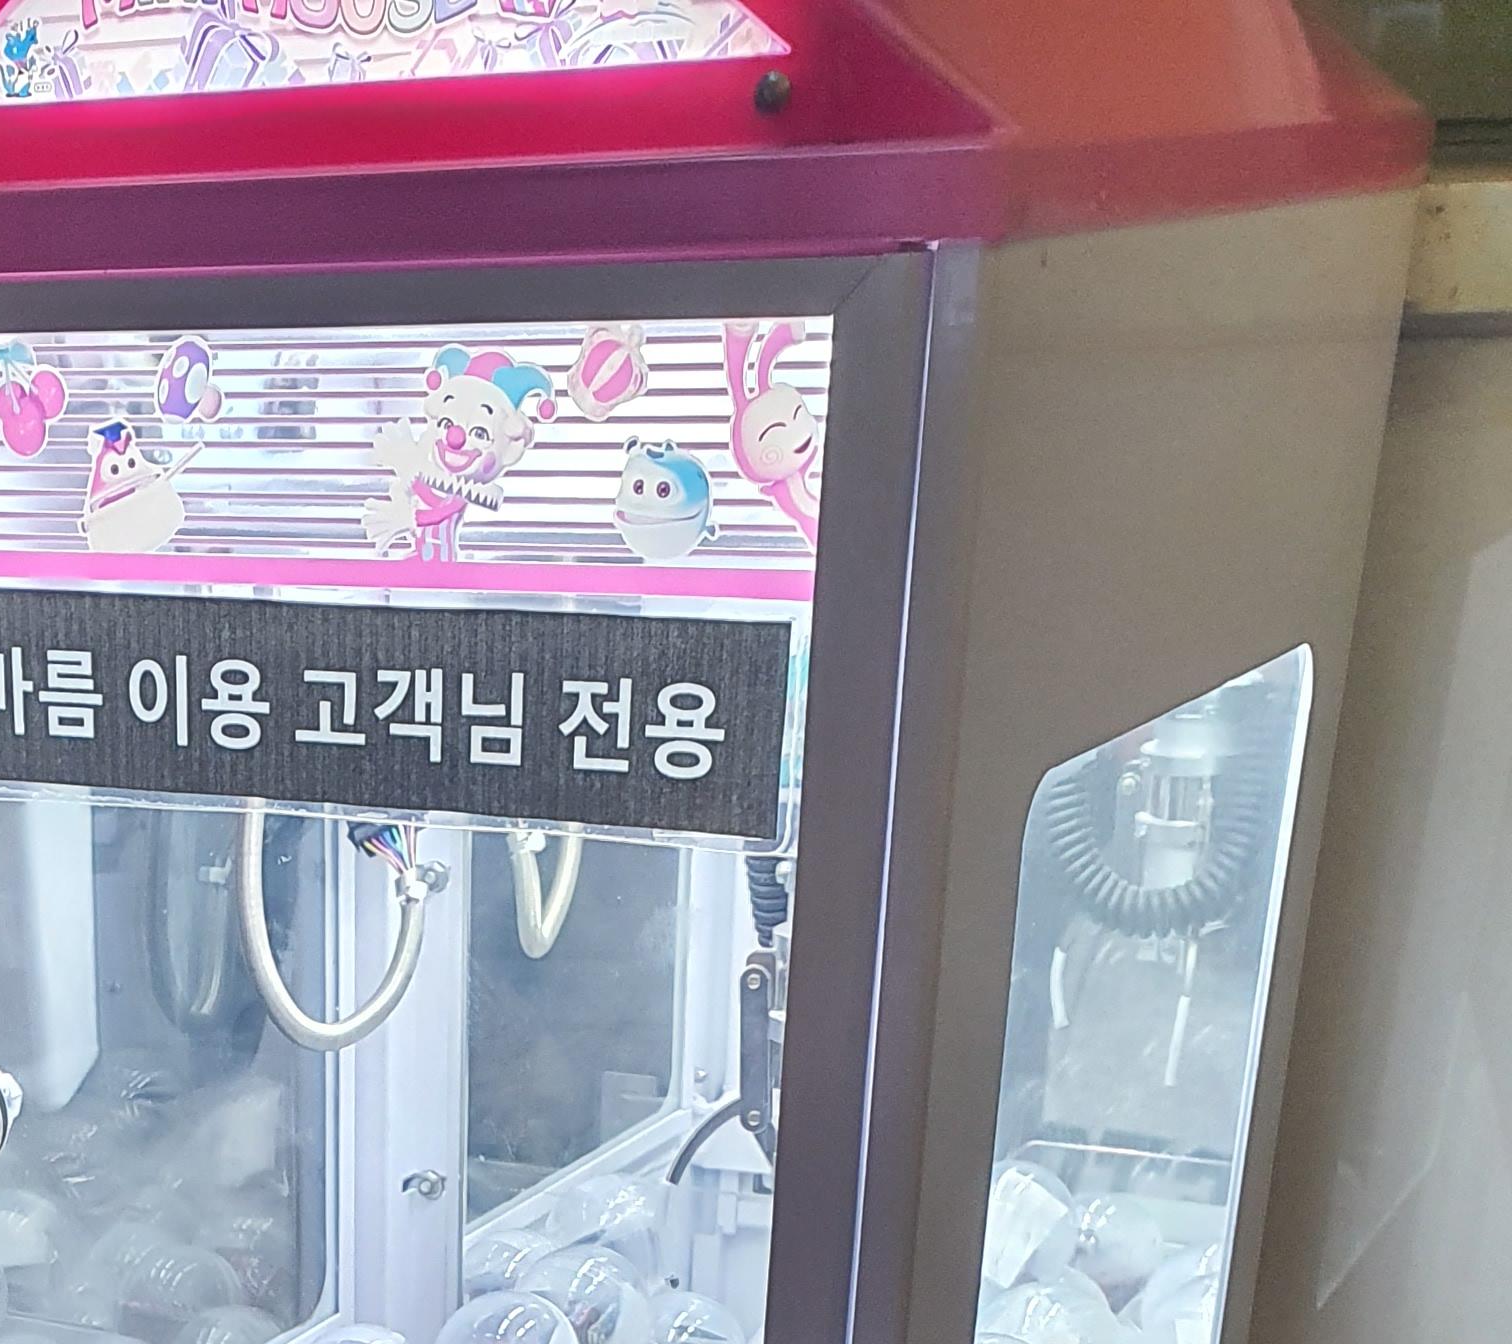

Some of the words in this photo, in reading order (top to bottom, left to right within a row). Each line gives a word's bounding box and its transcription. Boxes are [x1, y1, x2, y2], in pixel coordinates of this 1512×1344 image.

[129, 655, 270, 750] 이용
[294, 668, 525, 767] 고객님
[558, 677, 725, 780] 전용
